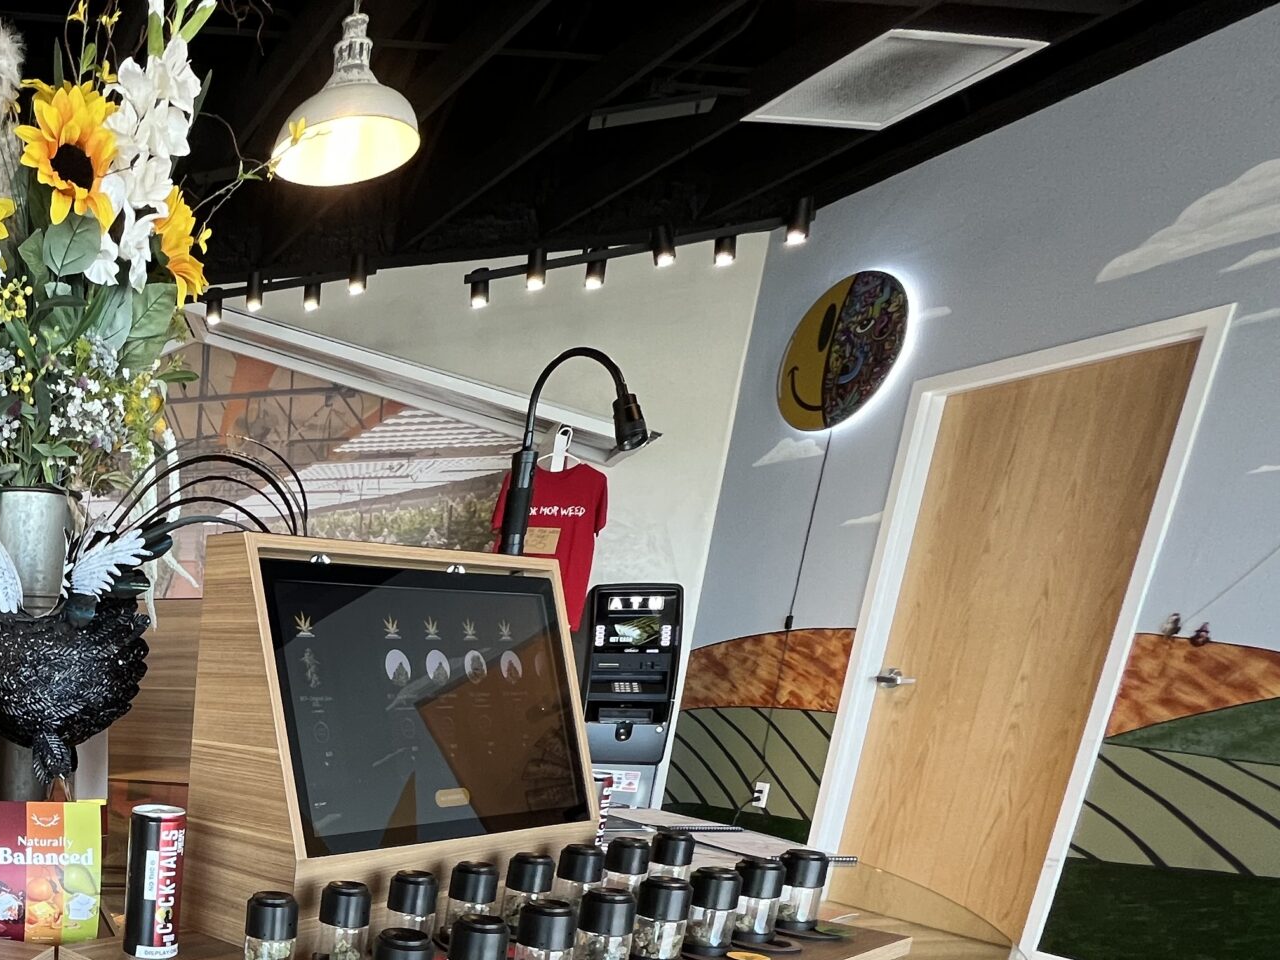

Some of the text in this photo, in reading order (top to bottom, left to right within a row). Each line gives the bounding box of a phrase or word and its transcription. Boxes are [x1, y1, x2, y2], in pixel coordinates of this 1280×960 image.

[560, 505, 586, 517] WEED
[609, 596, 664, 610] ATM
[17, 835, 74, 849] Naturally
